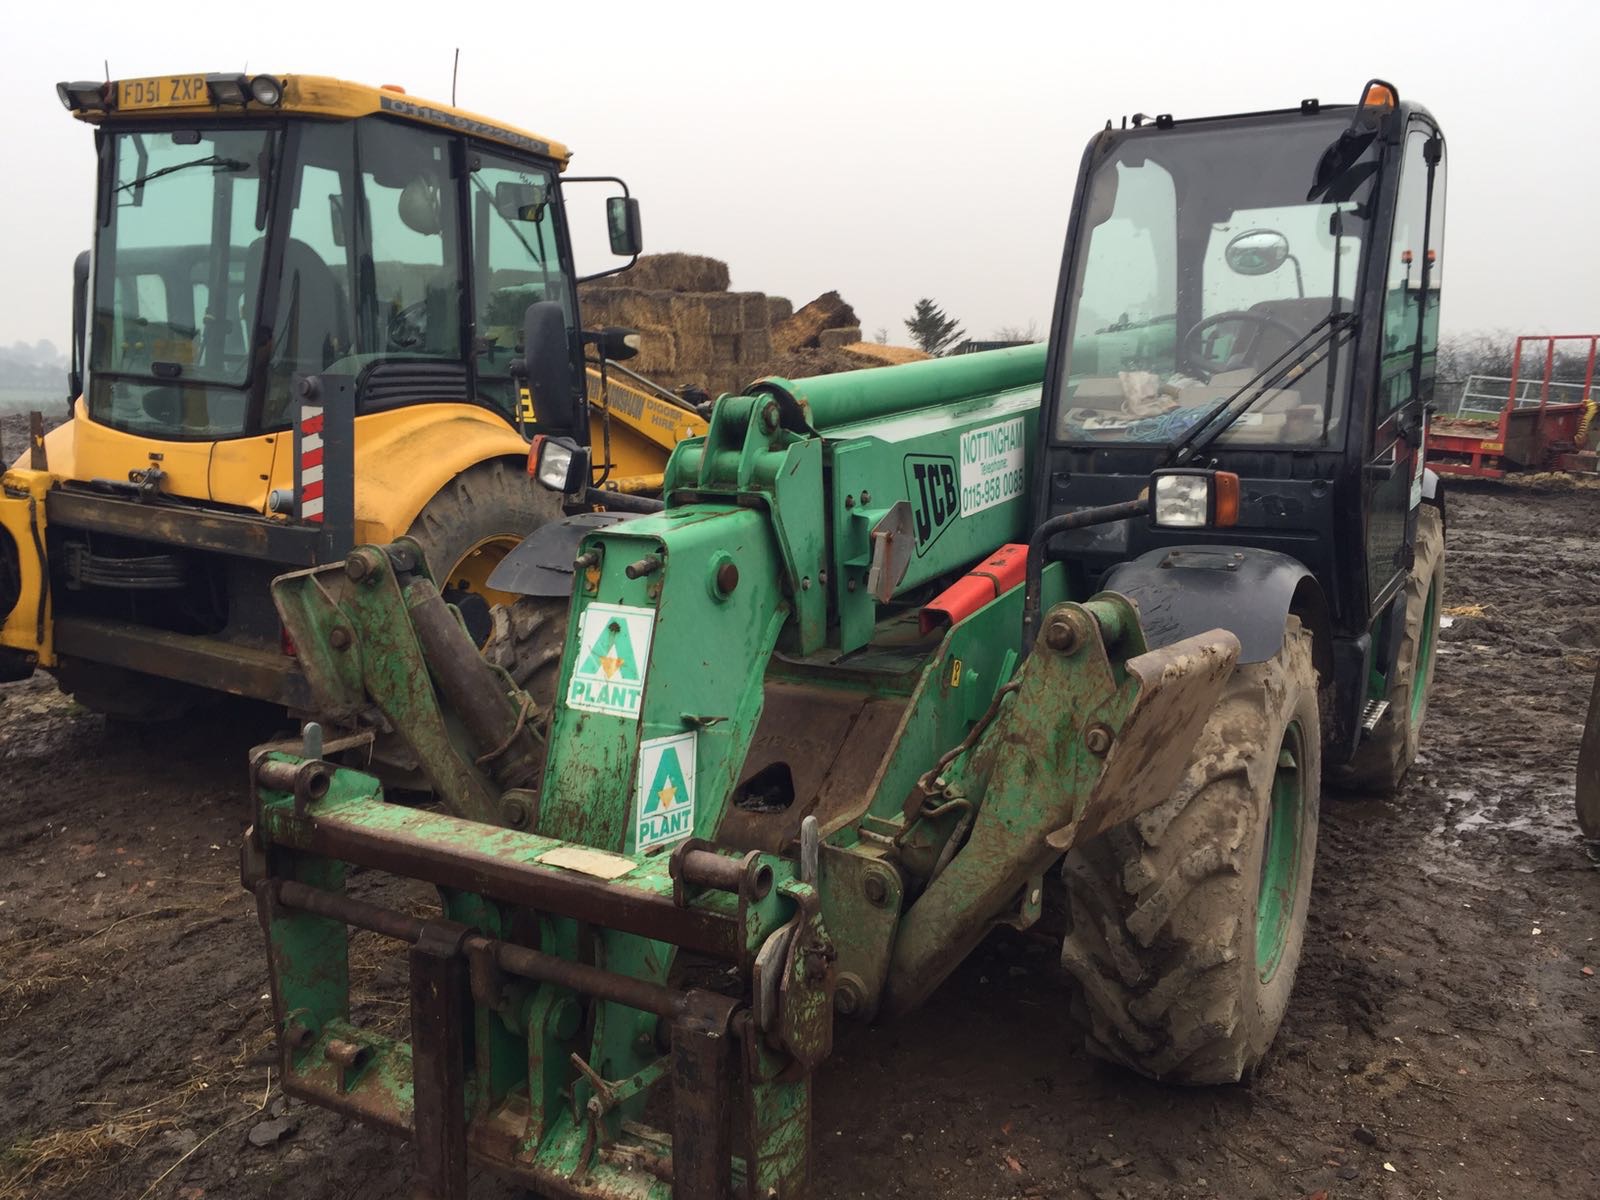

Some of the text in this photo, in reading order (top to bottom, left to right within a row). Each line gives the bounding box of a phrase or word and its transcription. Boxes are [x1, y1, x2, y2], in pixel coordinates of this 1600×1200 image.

[124, 79, 204, 105] FD51 ZXP
[646, 400, 682, 420] DIGGER
[651, 414, 676, 431] HIRE
[963, 422, 1024, 465] NOTTINGHAM
[913, 464, 957, 547] JCB
[963, 468, 1024, 512] 0115-958 0085
[571, 680, 641, 709] PLANT
[639, 809, 692, 844] PLANT
